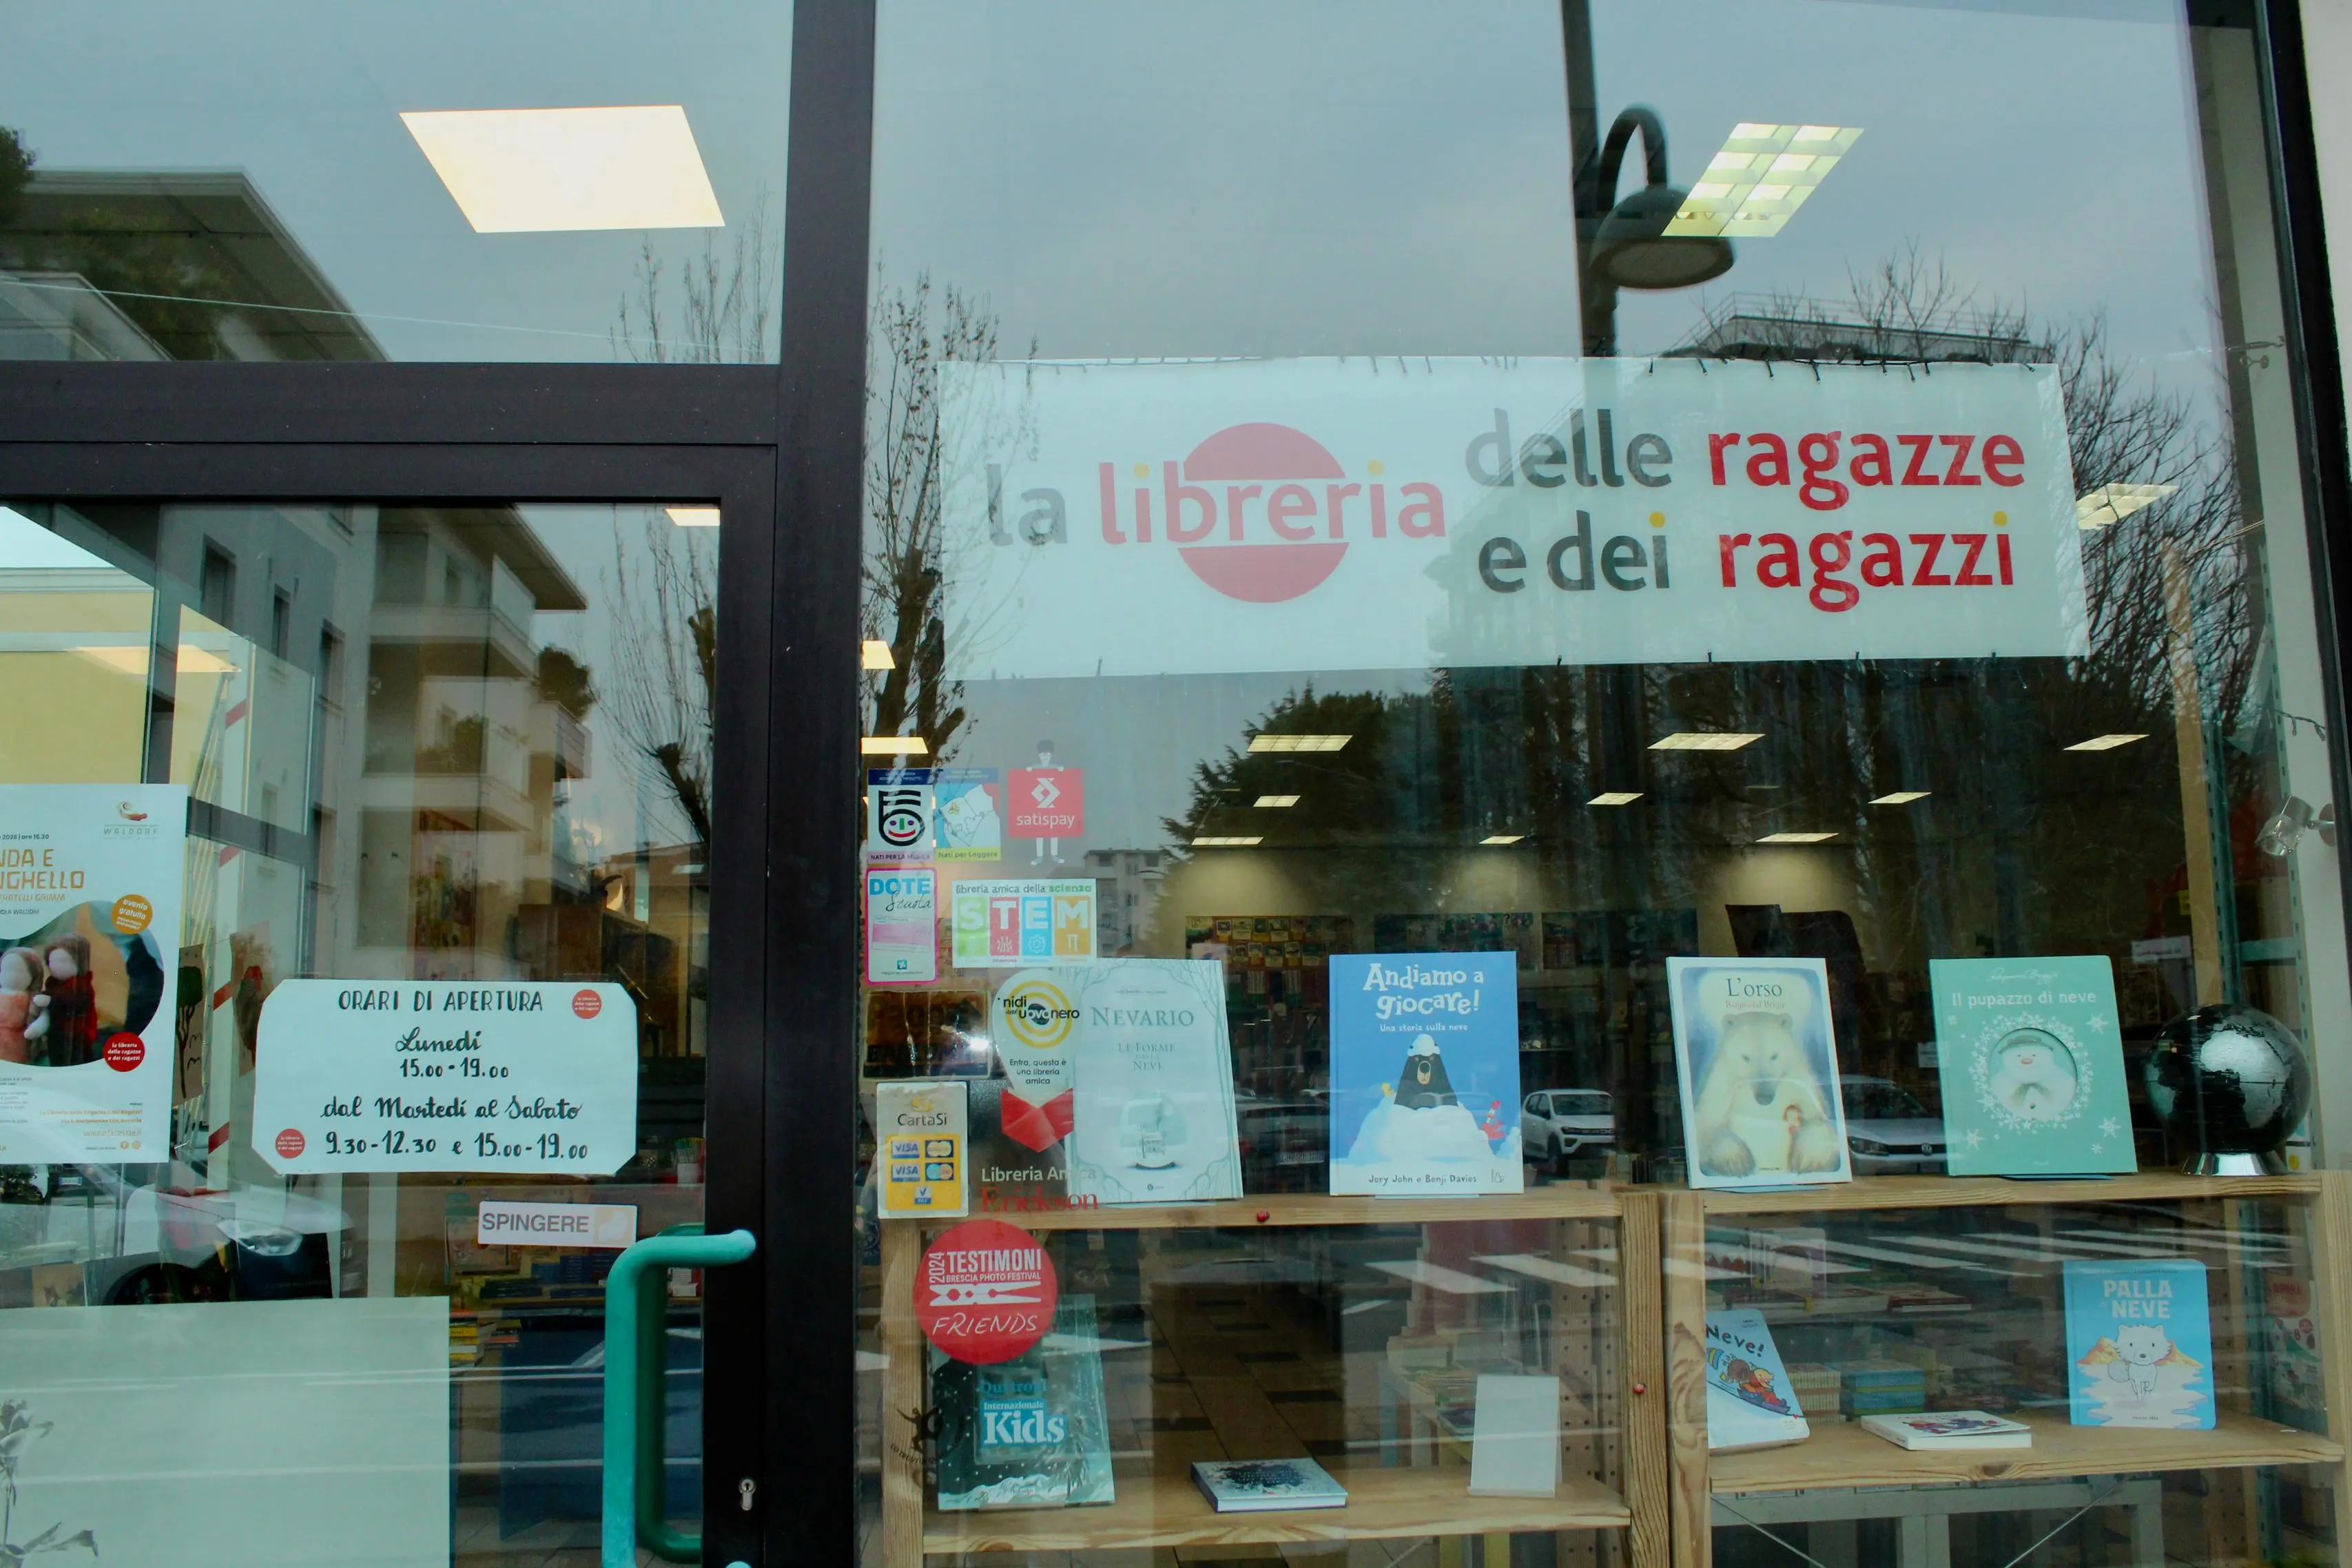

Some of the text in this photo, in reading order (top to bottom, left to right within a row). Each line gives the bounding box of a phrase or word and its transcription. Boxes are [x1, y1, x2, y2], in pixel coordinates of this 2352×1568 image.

[1465, 408, 2026, 511] delle ragazze
[987, 459, 1446, 547] la libreria
[1478, 510, 2015, 612] e dei ragazzi
[1016, 812, 1075, 829] satispay
[43, 849, 54, 867] E
[955, 852, 966, 860] per
[968, 851, 998, 860] Leggere
[869, 878, 932, 896] DOTE
[956, 884, 1092, 894] libreria amica della scienza
[885, 889, 933, 911] Scuola
[960, 900, 1089, 930] STEM
[1363, 962, 1484, 991] Andiamo a
[1725, 977, 1782, 997] L'orso
[338, 990, 543, 1011] ORARI DI APERTURA
[1003, 996, 1027, 1007] nidi
[1375, 989, 1480, 1020] giocare!
[1725, 1001, 1762, 1009] Raymond
[1952, 991, 2096, 1009] Il pupazzo di neve
[1090, 1006, 1195, 1027] NEVARIO
[1379, 1022, 1468, 1032] Una storia sulla neve
[1135, 1042, 1176, 1053] FORME
[1033, 1059, 1060, 1067] questa
[1133, 1060, 1164, 1071] NEVE
[320, 1095, 362, 1119] dal
[474, 1102, 499, 1119] al
[504, 1094, 584, 1120] Sabato
[898, 1113, 947, 1126] CartaSi
[452, 1140, 463, 1156] e
[896, 1143, 918, 1152] VISA
[896, 1166, 918, 1175] VISA
[982, 1166, 1043, 1182] Libreria
[1368, 1174, 1389, 1186] Jory
[1392, 1174, 1413, 1183] John
[1425, 1174, 1447, 1186] Benji
[1450, 1174, 1477, 1183] Davies
[980, 1184, 1100, 1213] Erickson
[482, 1212, 589, 1233] SPINGERE
[929, 1248, 1042, 1283] 2024 TESTIMONI
[946, 1272, 1041, 1283] BRESCIA PHOTO FESTIVAL
[2103, 1280, 2173, 1299] PALLA
[2112, 1300, 2170, 1319] NEVE
[932, 1312, 1038, 1337] FRIENDS
[1706, 1323, 1764, 1357] Neve!
[984, 1401, 1044, 1410] Internazionale
[984, 1410, 1064, 1444] Kids
